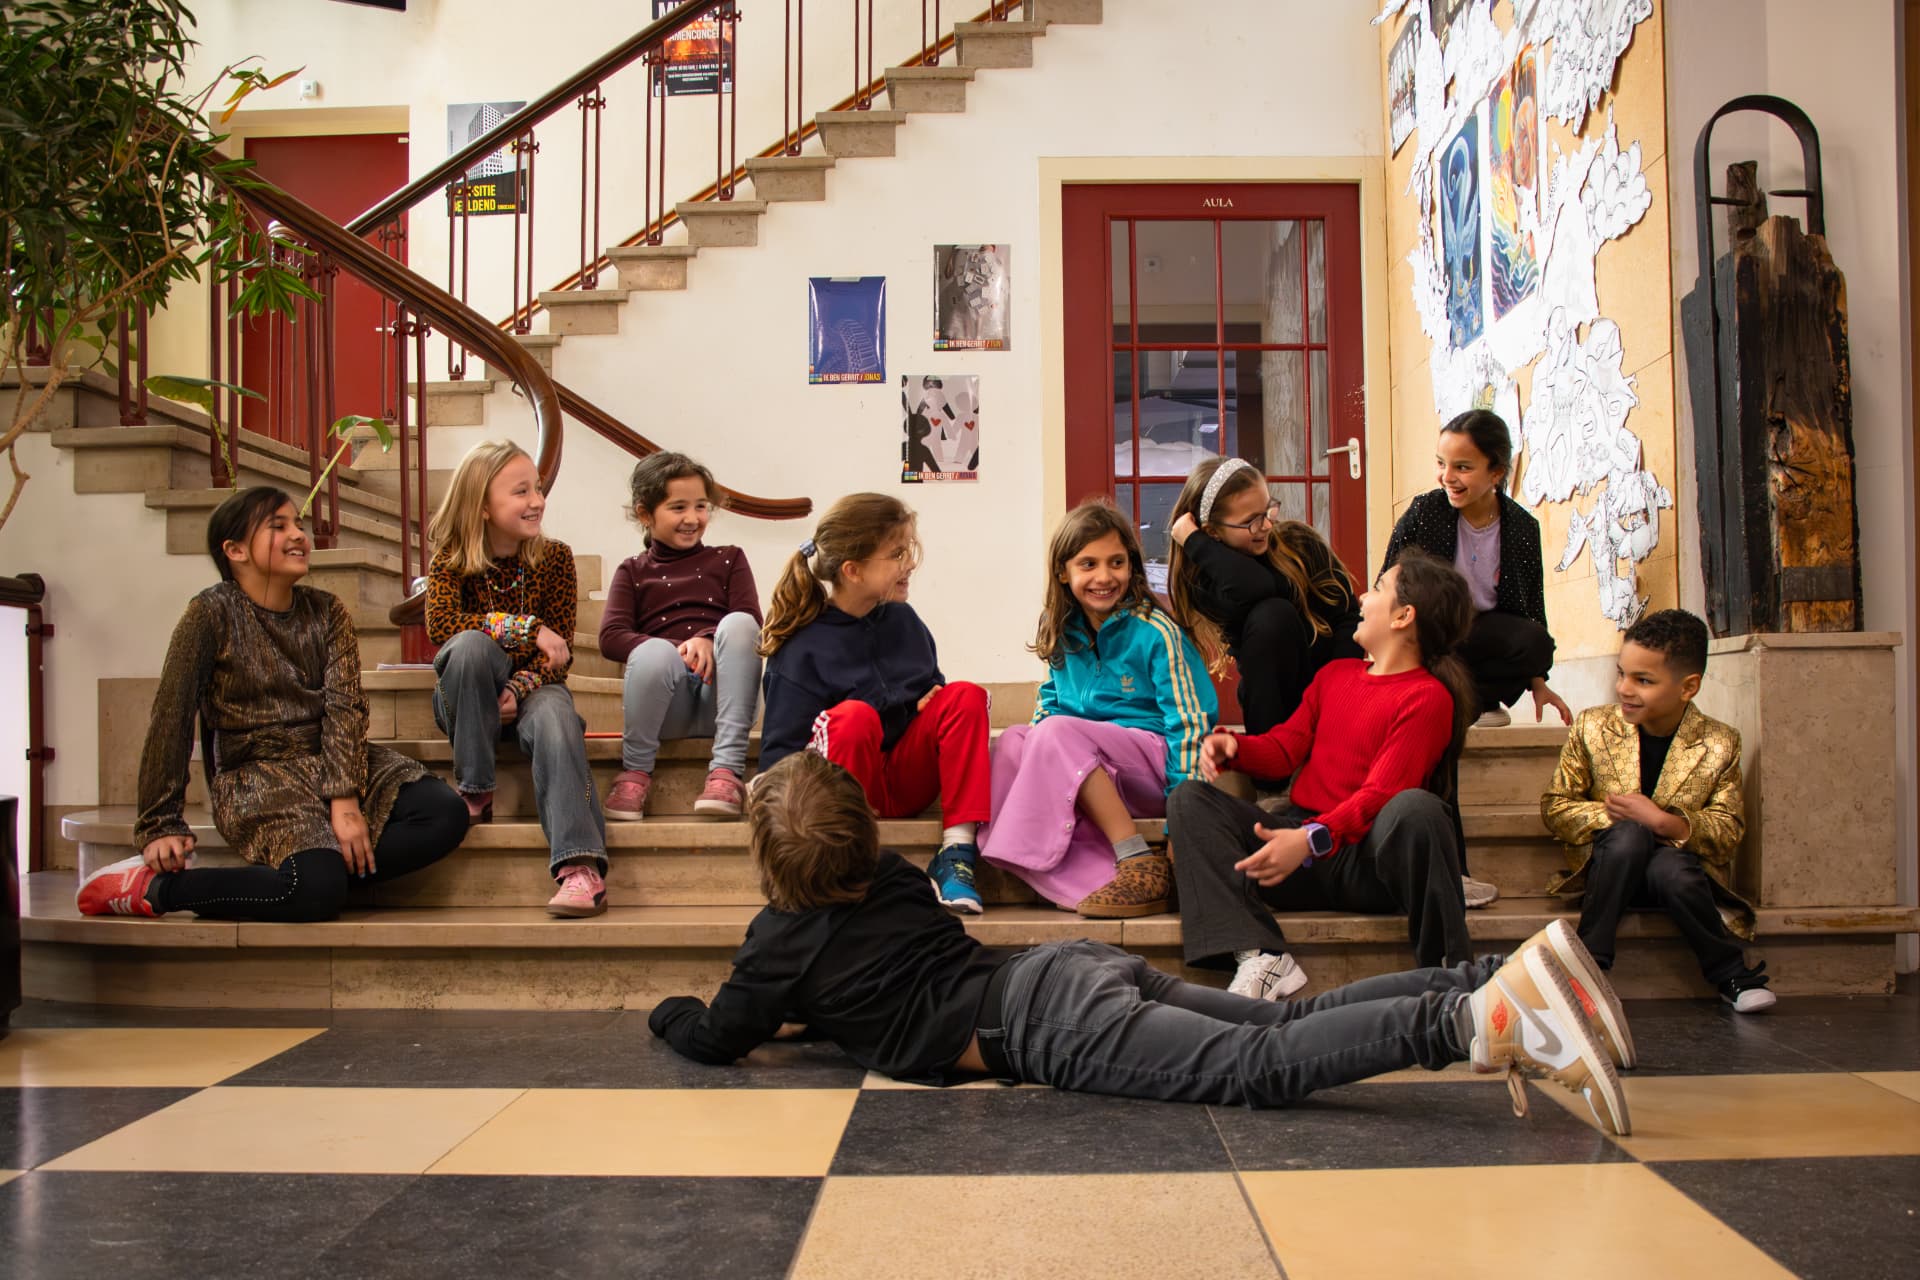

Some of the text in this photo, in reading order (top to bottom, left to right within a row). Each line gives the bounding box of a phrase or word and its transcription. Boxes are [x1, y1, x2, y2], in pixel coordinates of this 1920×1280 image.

[664, 27, 727, 41] AMENCONCE
[455, 184, 497, 198] SITIE
[453, 199, 496, 213] ELDEND
[1202, 198, 1234, 208] AULA
[829, 373, 840, 382] BEN
[840, 373, 859, 382] GERRIT
